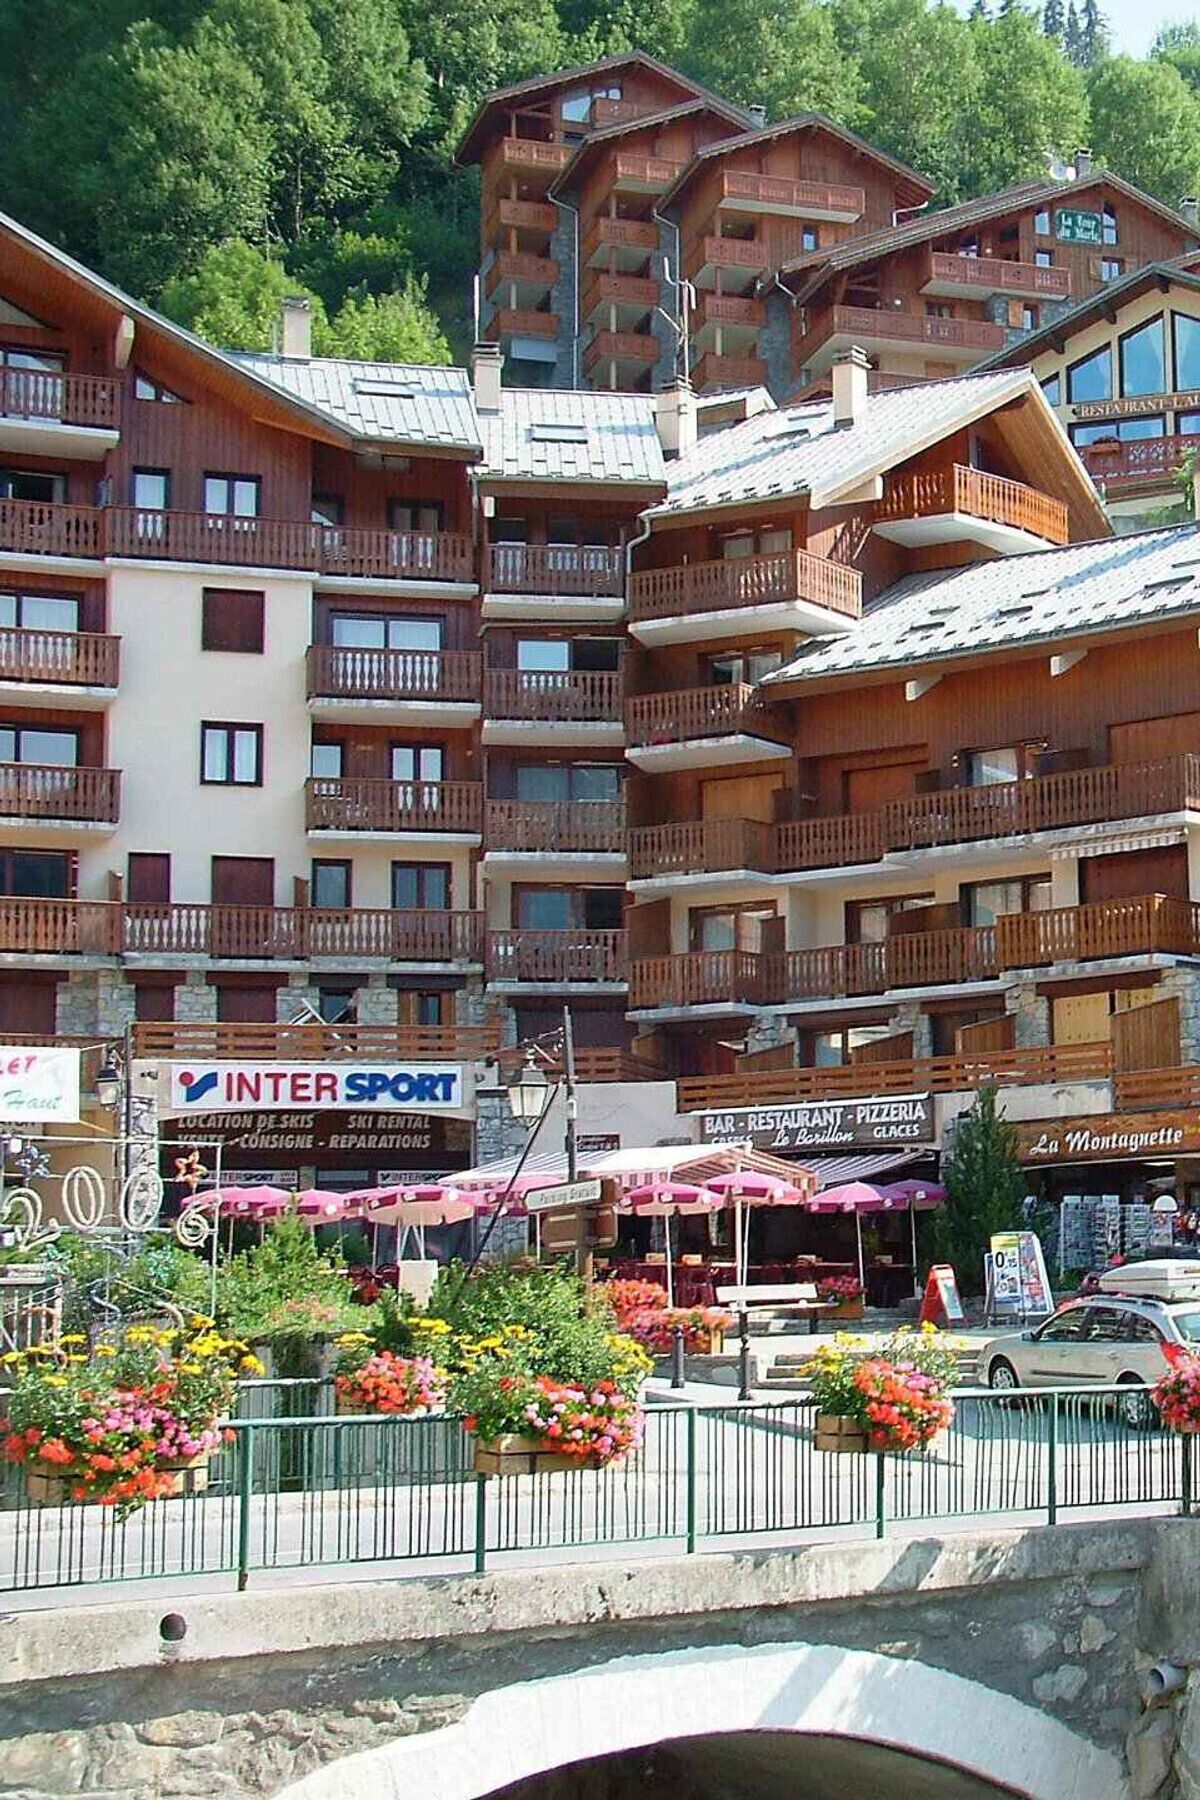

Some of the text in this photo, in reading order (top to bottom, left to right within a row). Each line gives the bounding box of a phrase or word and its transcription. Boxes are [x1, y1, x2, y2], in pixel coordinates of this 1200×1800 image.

[0, 1054, 37, 1075] ET
[178, 1113, 315, 1129] LOCATION DE SKIS
[347, 1114, 431, 1129] SKI RENTAL
[705, 1115, 735, 1134] BAR
[748, 1107, 844, 1131] RESTAURANT
[856, 1102, 927, 1124] PIZZERIA
[771, 1130, 790, 1147] Le
[873, 1125, 920, 1139] GLACES
[239, 1133, 314, 1149] CONSIGNE
[329, 1134, 432, 1149] REPARATIONS
[1030, 1133, 1059, 1156] La
[1065, 1127, 1184, 1152] Montagnette
